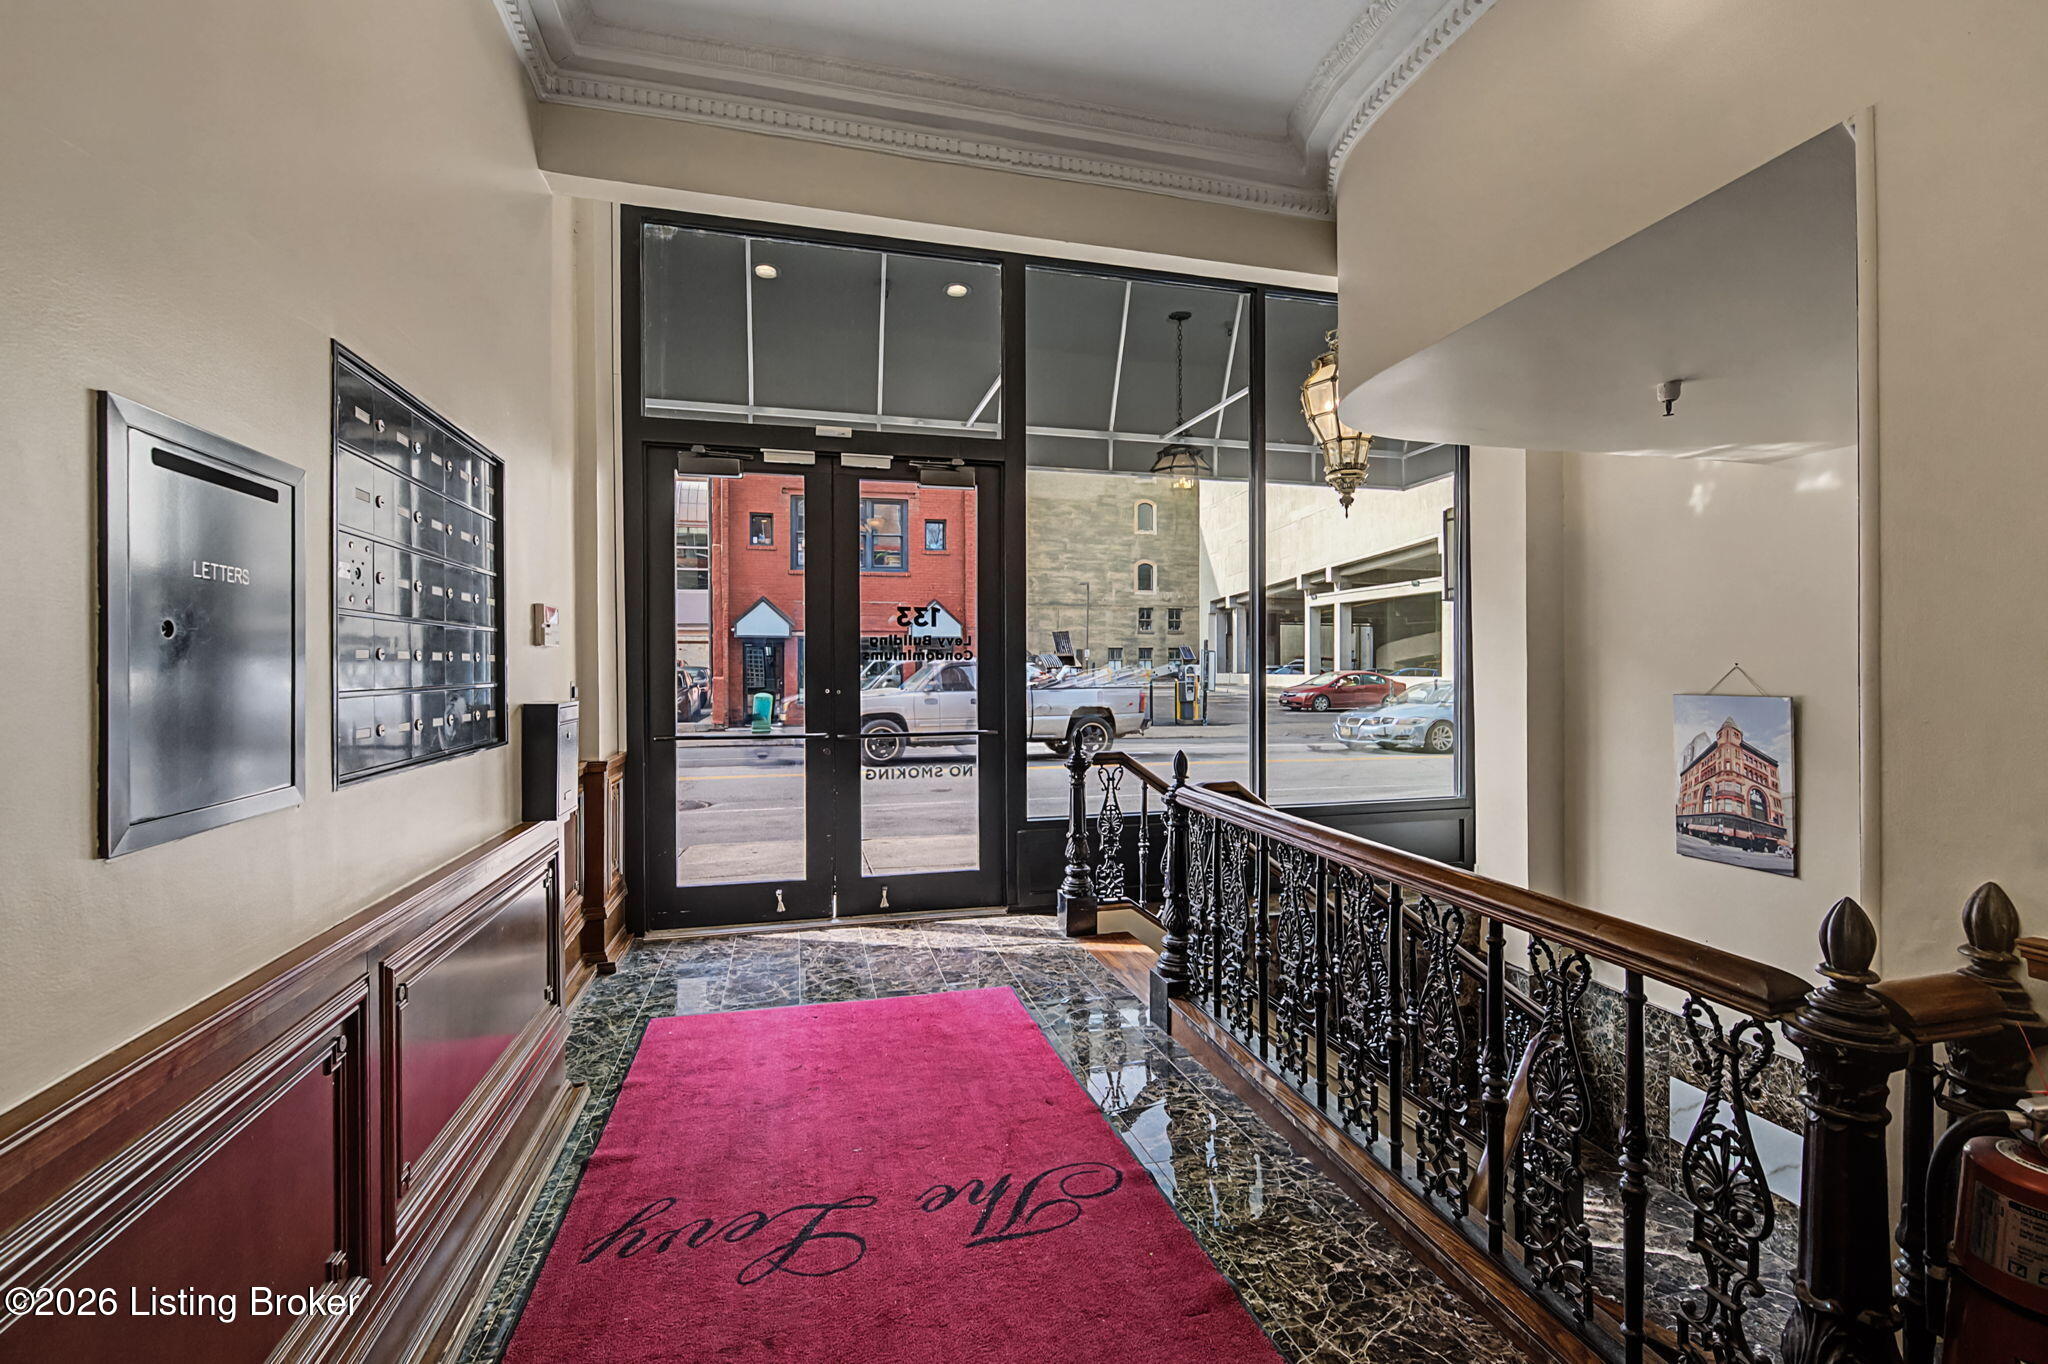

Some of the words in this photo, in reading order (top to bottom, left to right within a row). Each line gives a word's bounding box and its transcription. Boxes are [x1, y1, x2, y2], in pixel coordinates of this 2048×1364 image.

[193, 560, 250, 585] LETTERS
[578, 1196, 878, 1285] Levy
[917, 1162, 1123, 1248] The
